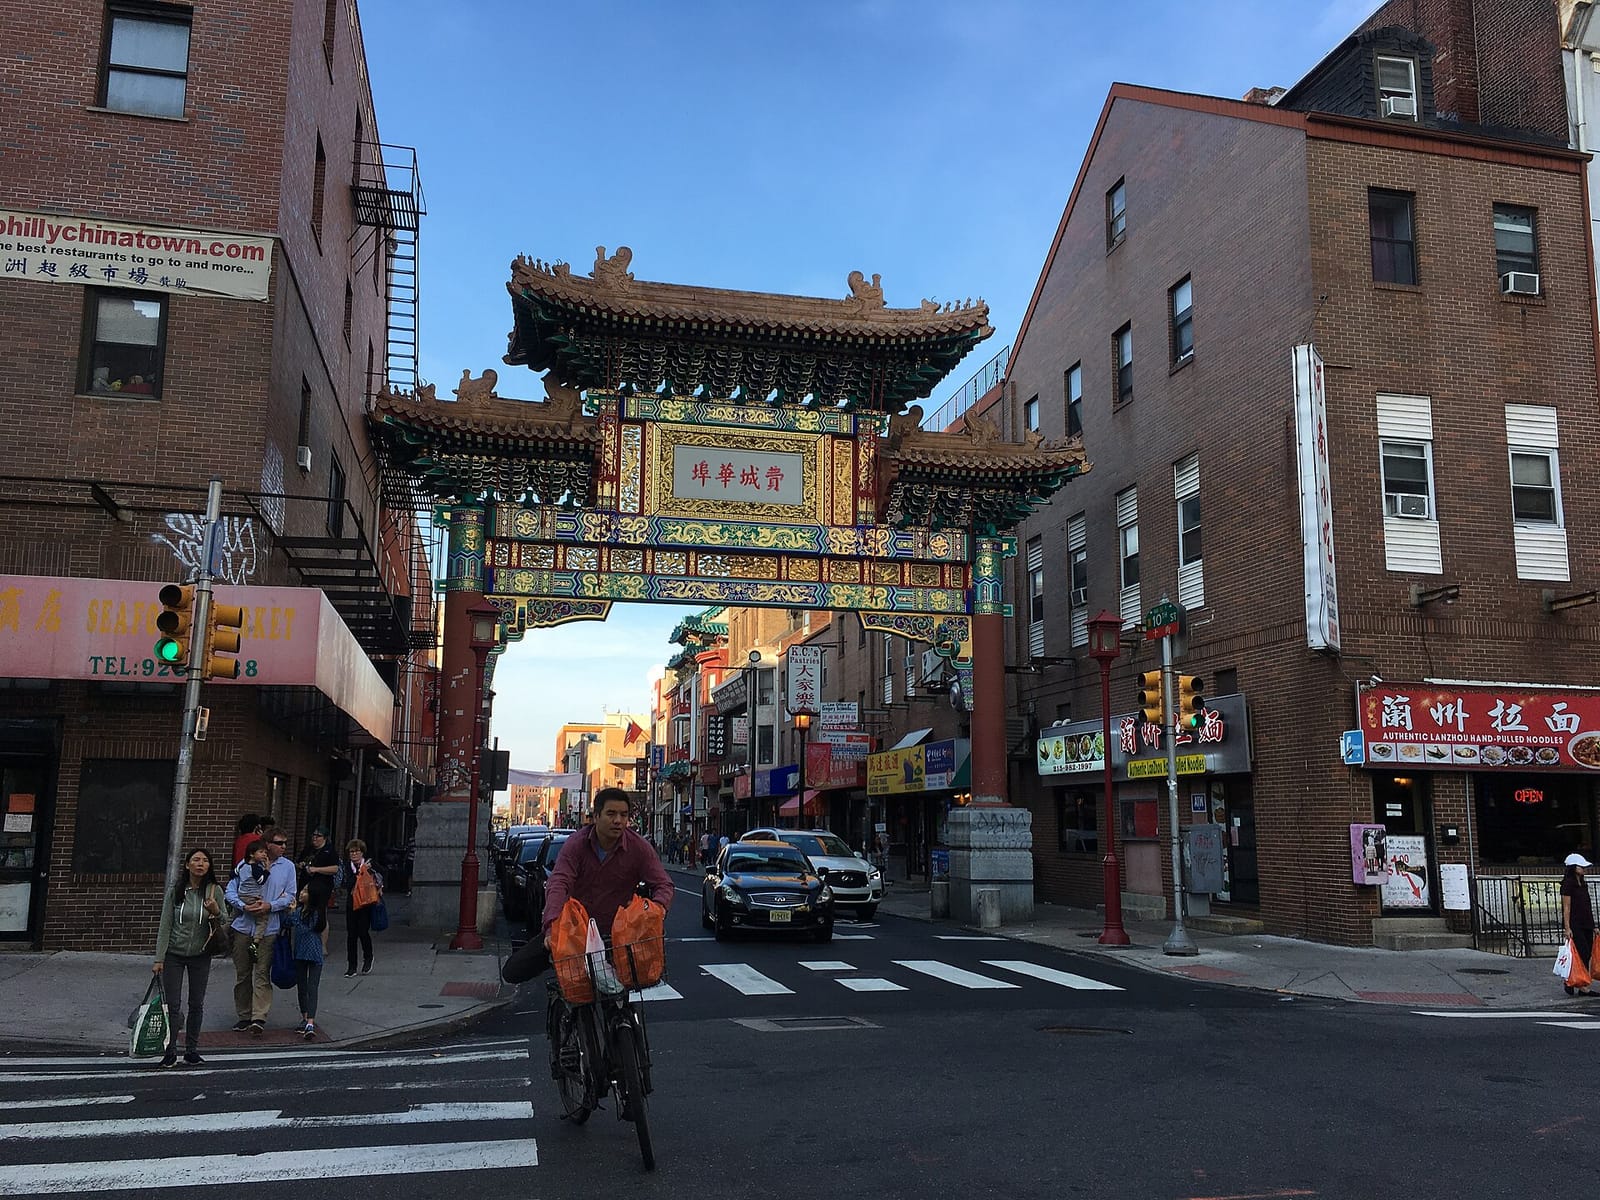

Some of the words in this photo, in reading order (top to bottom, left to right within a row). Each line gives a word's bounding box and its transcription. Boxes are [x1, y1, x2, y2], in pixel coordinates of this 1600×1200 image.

[17, 242, 46, 254] best
[51, 247, 127, 262] restaurants
[131, 254, 144, 263] to
[148, 257, 164, 267] go
[168, 257, 181, 267] to
[185, 261, 208, 270] and
[212, 263, 254, 274] more...
[791, 647, 819, 657] K.C.'s
[790, 656, 820, 665] Pastries
[716, 716, 724, 755] PENANG
[1383, 732, 1428, 741] AUTHENTIC
[1430, 733, 1469, 742] LANZHOU
[1469, 734, 1525, 744] HAND-PULLED
[1526, 736, 1564, 744] NOODLES
[1515, 790, 1544, 803] OPEN
